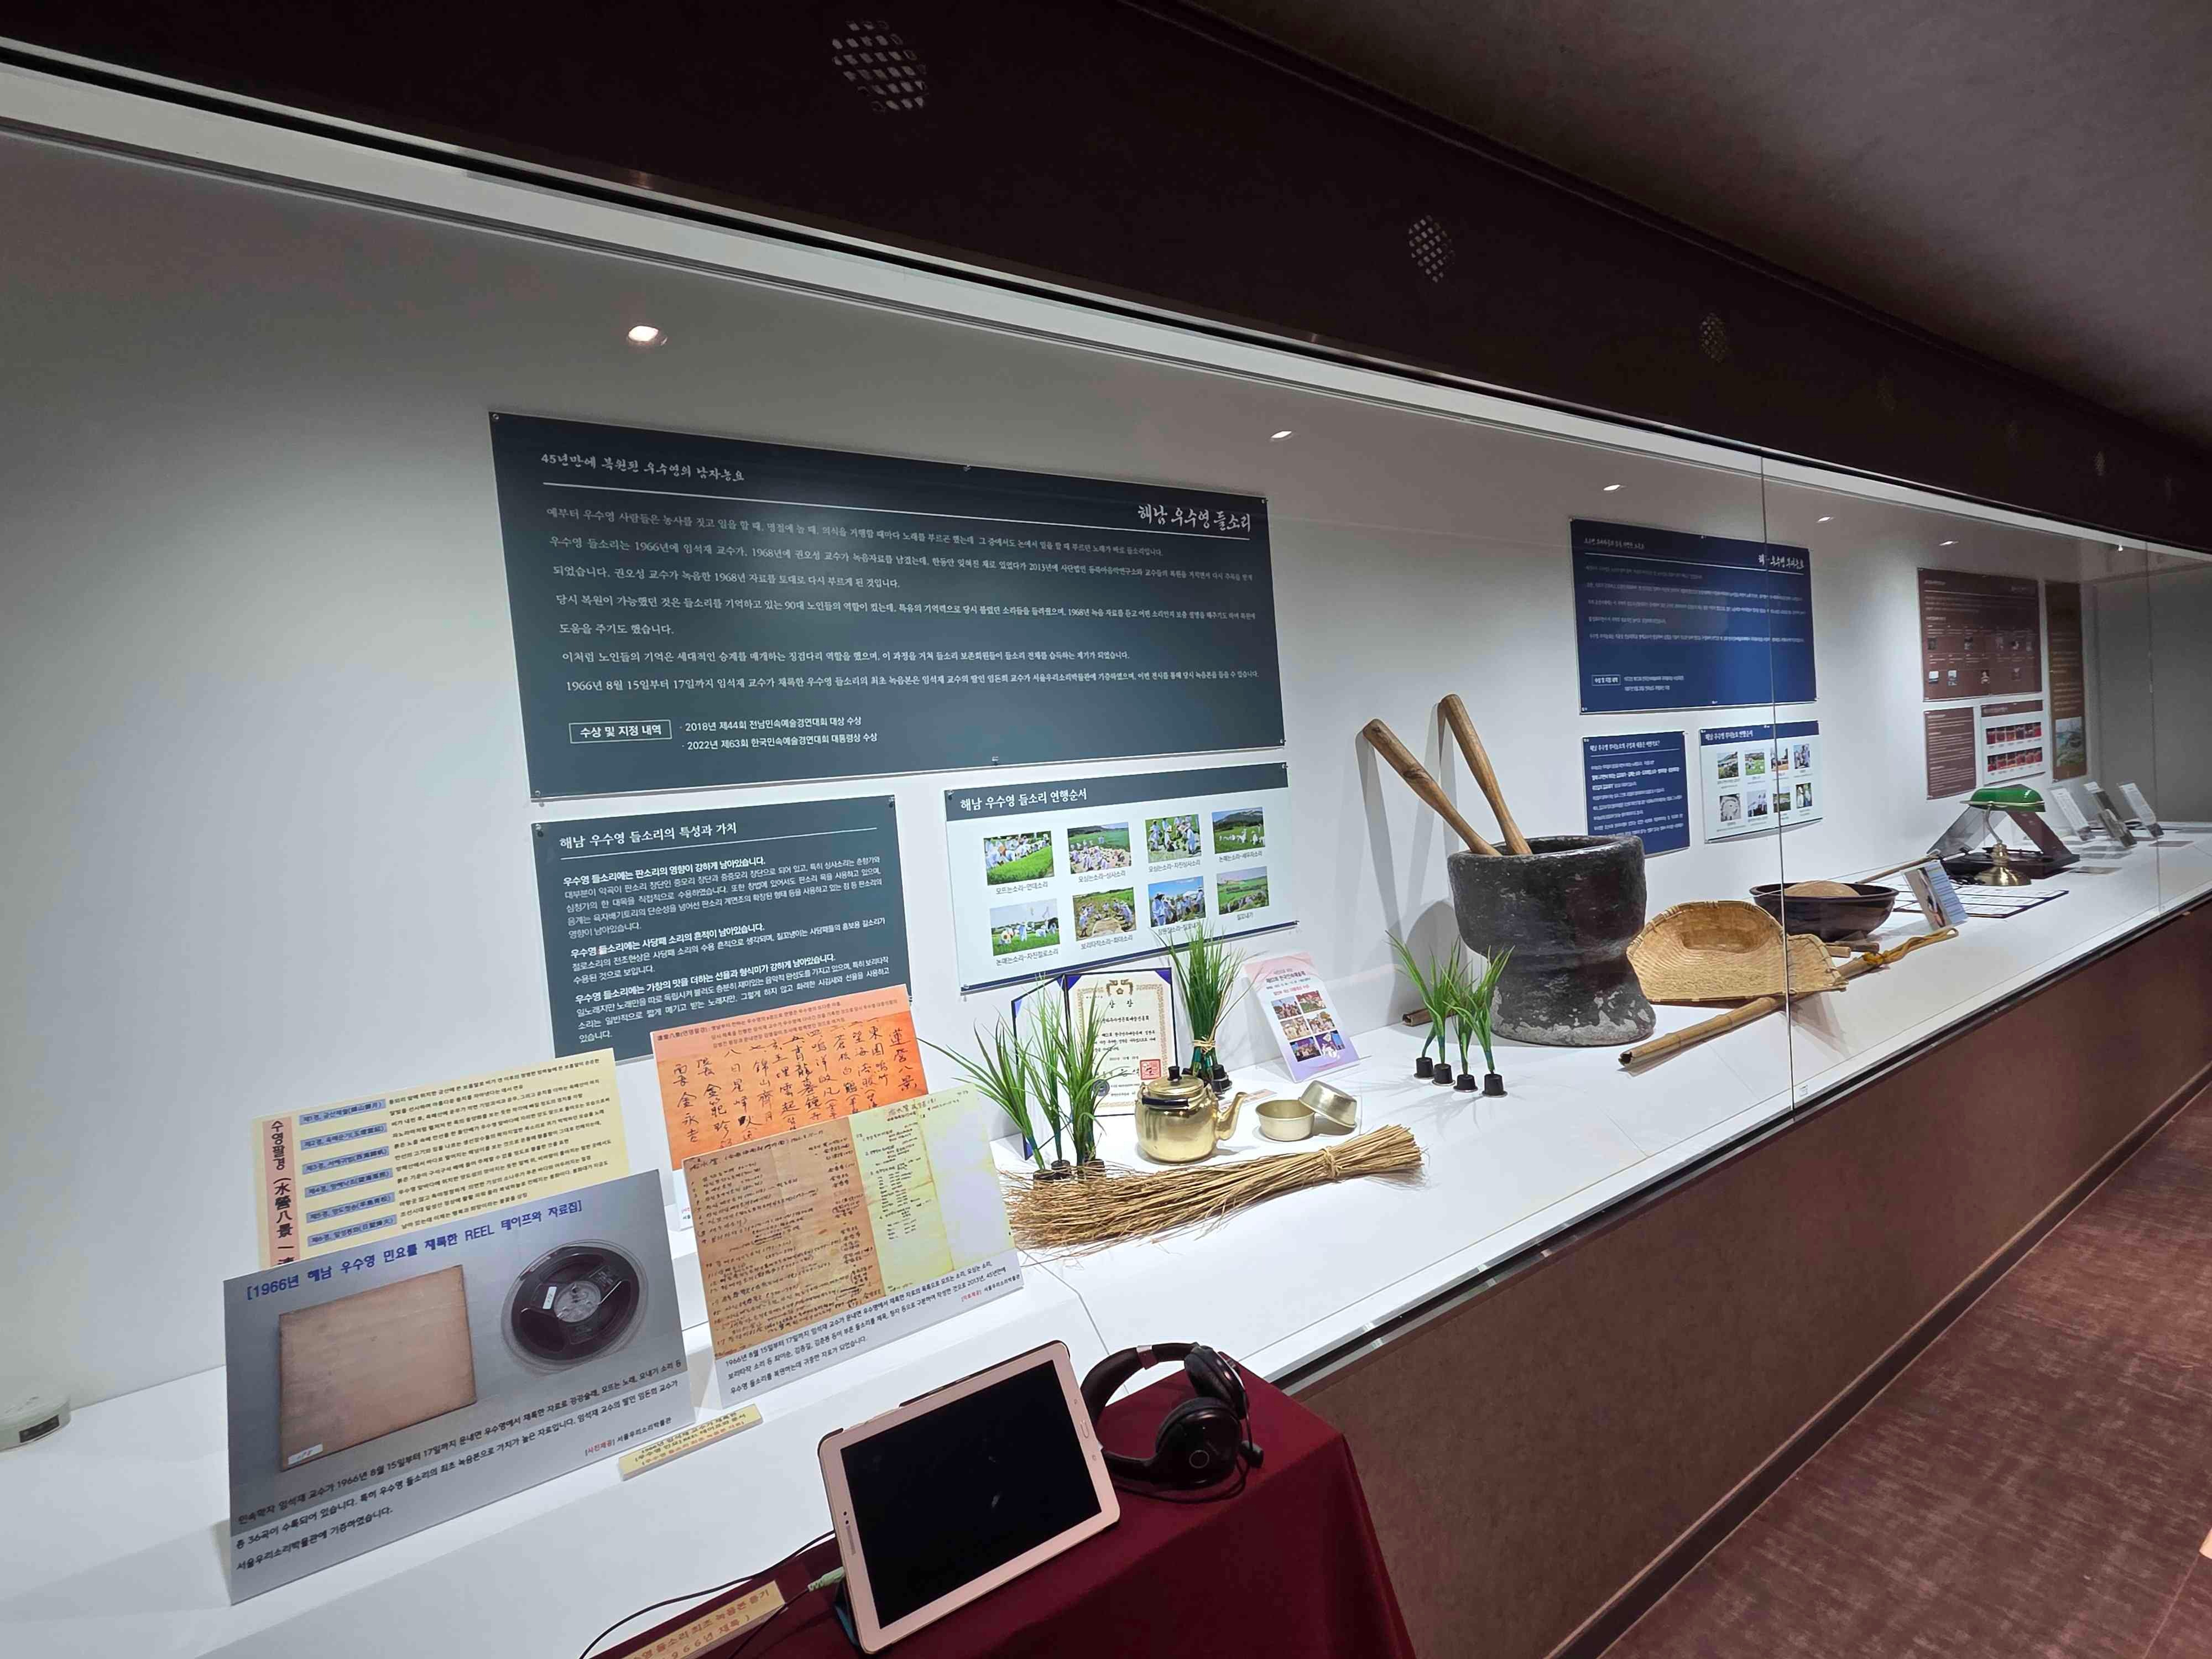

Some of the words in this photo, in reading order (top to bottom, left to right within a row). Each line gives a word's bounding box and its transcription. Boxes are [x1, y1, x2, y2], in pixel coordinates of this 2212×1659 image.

[1138, 504, 1167, 524] 해남
[1171, 508, 1209, 528] 우수영
[1214, 511, 1250, 532] 들소리
[560, 623, 592, 634] 도움을
[596, 624, 628, 634] 주기도
[631, 624, 674, 634] 했습니다.
[580, 727, 601, 738] 수상
[605, 726, 615, 737] 및
[618, 726, 638, 736] 지정
[641, 725, 661, 735] 내역
[685, 722, 716, 731] 2018년
[719, 721, 747, 730] 제44회
[750, 718, 827, 729] 전남민속예술경연대회
[830, 717, 844, 726] 대상
[847, 717, 861, 725] 수상
[687, 740, 718, 750] 2022년
[721, 739, 748, 748] 제63회
[751, 735, 829, 747] 한국민속예술경연대회
[832, 734, 860, 743] 대통령상
[863, 733, 877, 742] 수상
[961, 797, 982, 811] 해남
[985, 795, 1015, 809] 우수영
[1019, 791, 1047, 806] 들소리
[1050, 788, 1087, 802] 연행순서
[560, 836, 585, 849] 해남
[589, 832, 624, 846] 우수영
[629, 827, 675, 843] 들소리의
[679, 825, 712, 838] 특성과
[716, 822, 736, 834] 가치
[564, 875, 589, 886] 우수영
[592, 872, 633, 883] 들소리에는
[635, 867, 667, 878] 판소리의
[669, 864, 693, 875] 영향이
[695, 862, 718, 872] 강하게
[719, 857, 765, 869] 남아있습니다.
[571, 947, 597, 958] 우수영
[599, 942, 640, 954] 들소리에는
[642, 937, 666, 947] 사당패
[669, 933, 692, 943] 소리의
[694, 930, 717, 941] 흔적이
[718, 924, 765, 937] 남아있습니다.
[575, 992, 601, 1004] 우수영
[604, 986, 645, 999] 들소리에는
[646, 980, 671, 992] 가창의
[672, 978, 688, 988] 맛을
[691, 974, 713, 984] 더하는
[715, 969, 738, 980] 선율과
[740, 964, 768, 977] 형식미가
[770, 961, 791, 971] 강하게
[792, 954, 836, 967] 남아있습니다.
[579, 1030, 612, 1043] 있습니다.
[271, 1120, 285, 1171] 수영팔경
[247, 1275, 299, 1300] [1966년
[307, 1266, 332, 1281] 해남
[341, 1255, 374, 1273] 우수영
[384, 1244, 417, 1262] 민요를
[425, 1233, 457, 1250] 채록한
[465, 1225, 495, 1241] REEL
[501, 1212, 541, 1230] 테이프와
[549, 1200, 582, 1217] 자료집]
